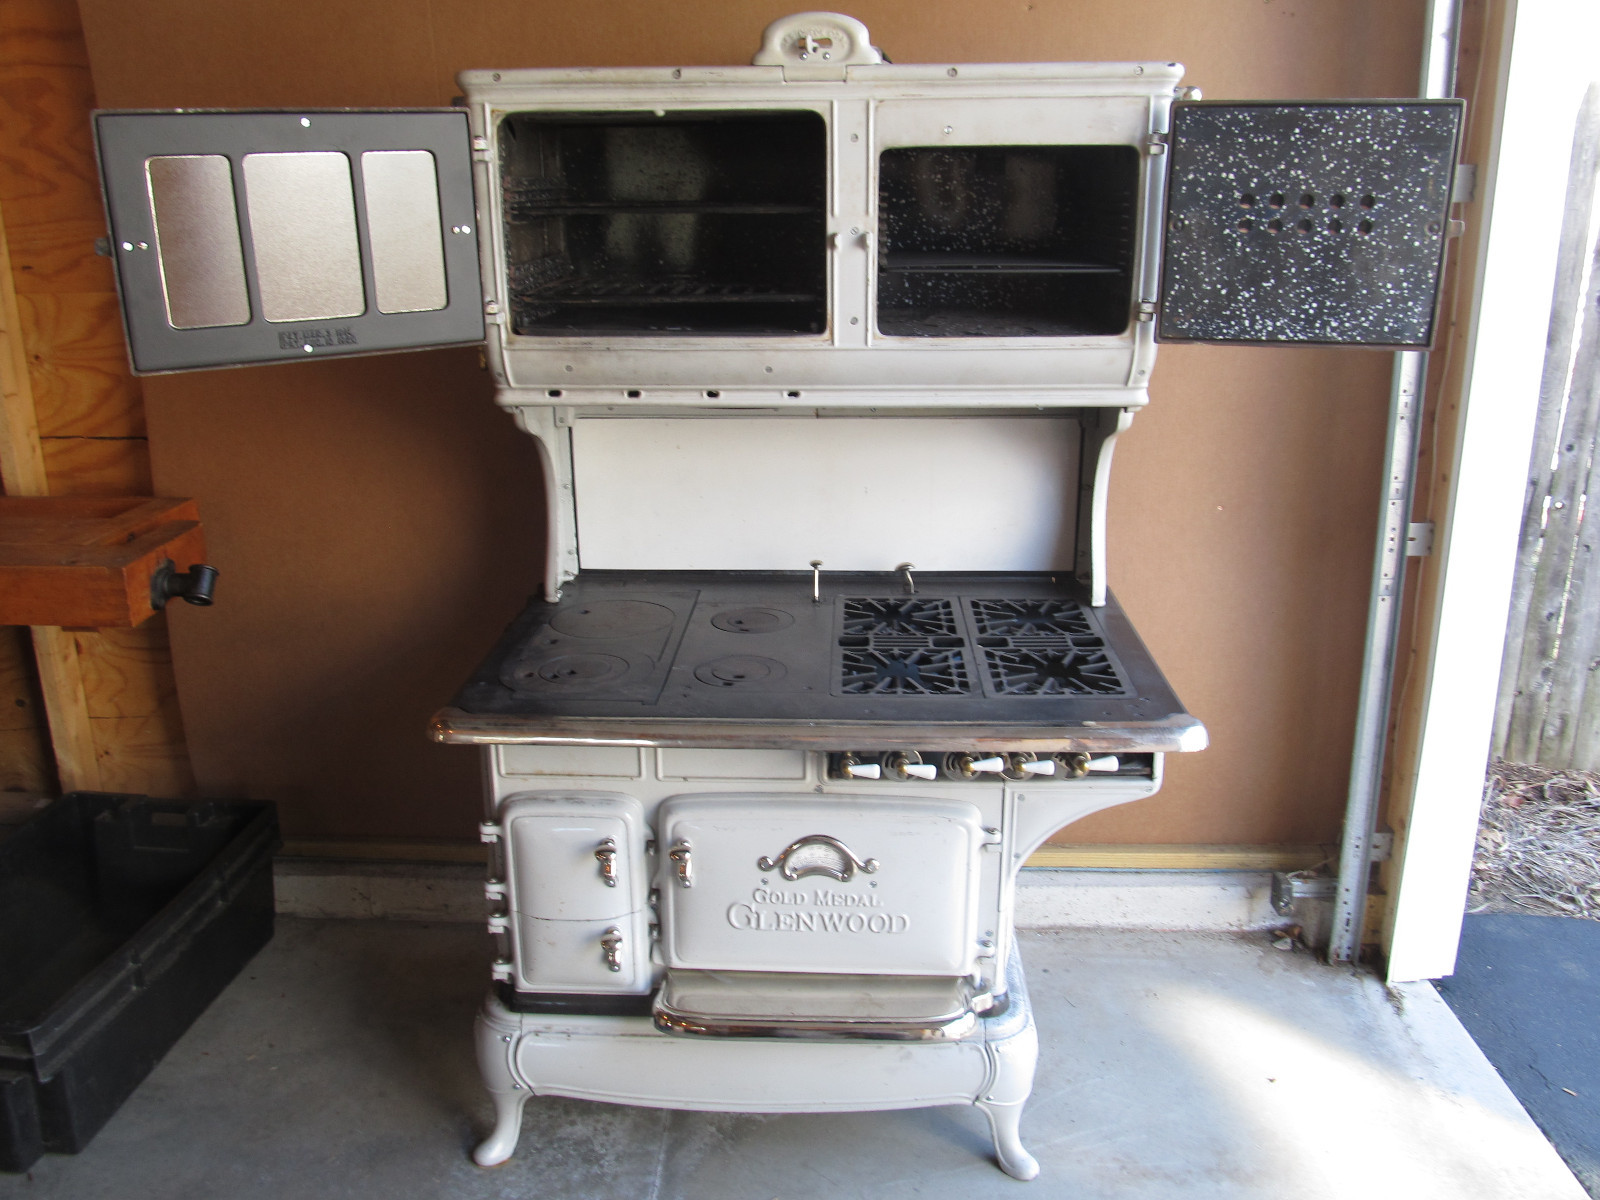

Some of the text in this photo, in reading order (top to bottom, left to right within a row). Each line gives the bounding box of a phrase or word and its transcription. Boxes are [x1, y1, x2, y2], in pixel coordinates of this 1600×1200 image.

[752, 887, 884, 907] GOLD MEDAL
[727, 901, 911, 933] GLENWOOD
